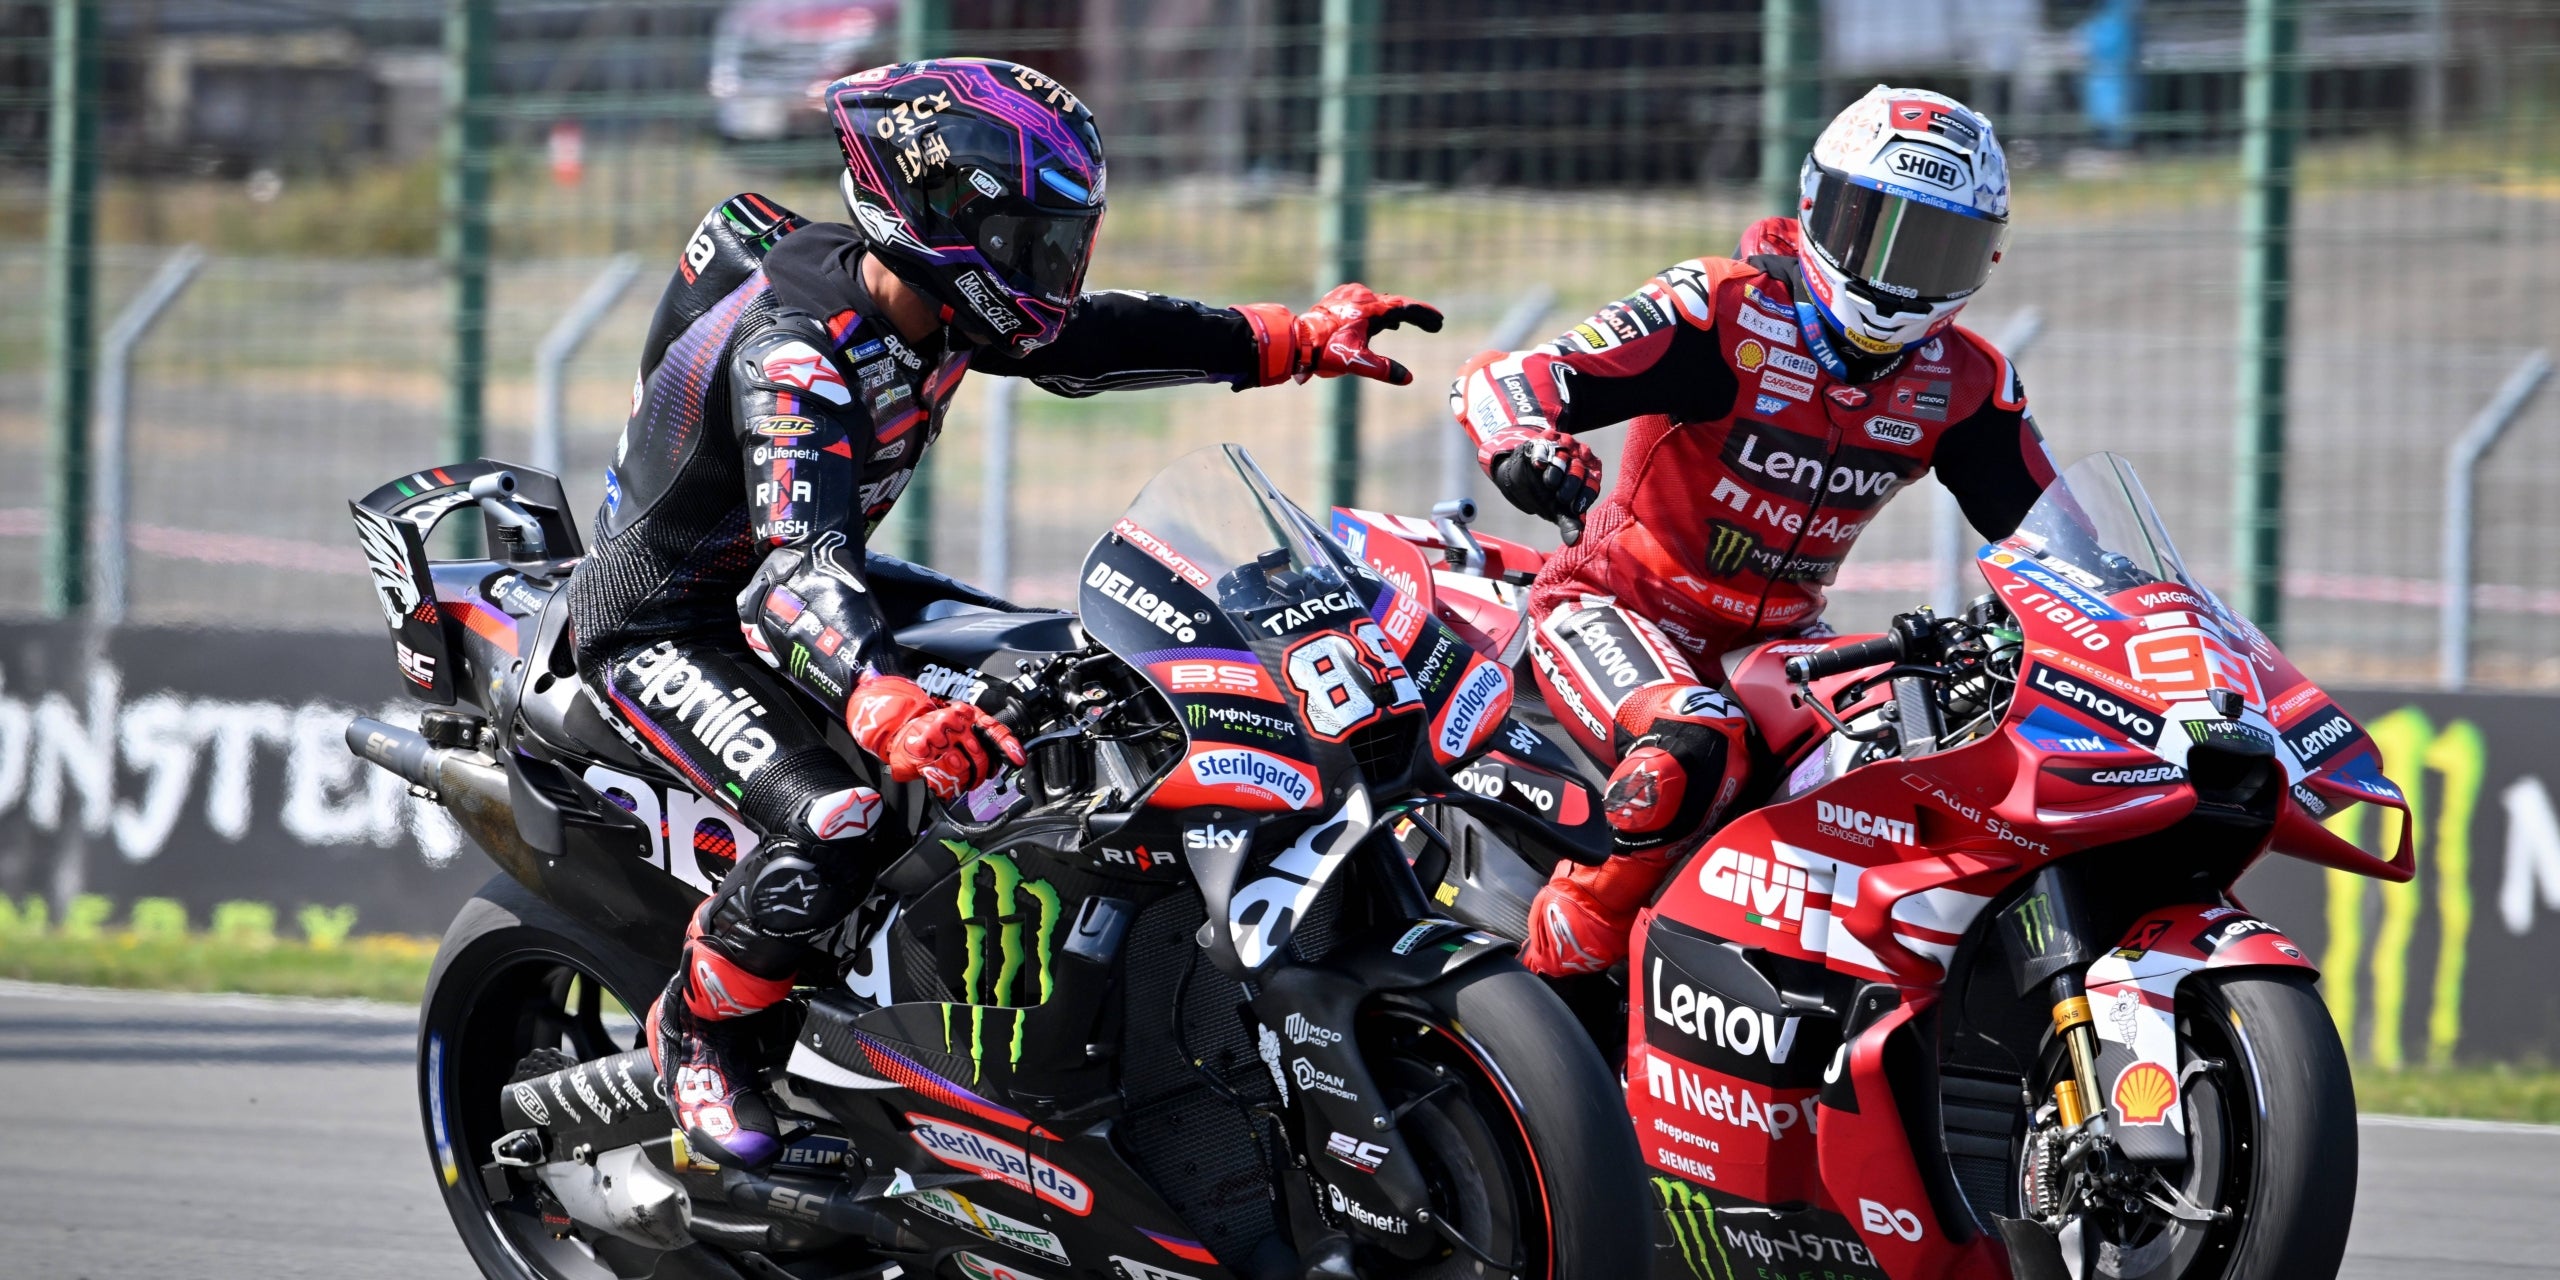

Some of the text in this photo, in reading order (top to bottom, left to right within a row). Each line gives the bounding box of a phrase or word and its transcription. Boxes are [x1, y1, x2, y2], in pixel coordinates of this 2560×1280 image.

[1934, 113, 1976, 137] Lenovo
[974, 174, 998, 195] 100%
[1896, 153, 1957, 186] SHOEI
[1885, 184, 1918, 201] Estrella
[1814, 240, 1841, 269] VERTICAL
[1868, 276, 1919, 299] Insta360
[1743, 312, 1793, 338] EATALY
[884, 334, 923, 370] aprilia
[1782, 355, 1817, 374] riello
[1813, 339, 1839, 370] TIM
[1763, 375, 1811, 394] CARRERA
[1914, 364, 1951, 374] motorola
[1504, 375, 1534, 414] Lenovo
[1755, 396, 1782, 413] SAP
[1917, 393, 1946, 404] Lenovo
[1873, 420, 1915, 440] SHOEI
[767, 448, 820, 462] Lifenet.it
[1737, 434, 1898, 497] Lenovo
[756, 520, 809, 540] MARSH
[1753, 500, 1869, 543] NetApp
[1347, 526, 1367, 559] TIM
[1383, 595, 1418, 642] BS
[2022, 593, 2110, 651] riello
[396, 641, 436, 678] SC
[1570, 611, 1640, 687] Lenovo
[1171, 664, 1259, 687] BS
[1429, 651, 1457, 694] ENERGY
[2061, 656, 2158, 702] FRECCIAROSSA
[625, 640, 777, 782] aprilia
[1446, 665, 1503, 751] sterilgarda
[2035, 669, 2155, 736] Lenovo
[1223, 723, 1285, 741] ENERGY
[1506, 721, 1543, 755] sky
[2059, 736, 2106, 751] TIM
[2289, 716, 2353, 762] Lenovo
[365, 732, 401, 764] SC
[1197, 753, 1308, 803] sterilgarda
[2091, 765, 2184, 784] CARRERA
[2358, 779, 2400, 800] TIM
[1234, 784, 1274, 802] alimenti
[1816, 800, 1916, 847] DUCATI
[1817, 822, 1875, 848] DESMOSEDICI
[1931, 788, 2050, 856] Audi Sport
[1187, 824, 1248, 854] sky
[1699, 846, 1808, 921] GIVI
[1396, 926, 1424, 951] Green
[1308, 1024, 1343, 1043] MOD
[1315, 1082, 1358, 1102] COMPOSITI
[1316, 1071, 1345, 1088] PAN
[1327, 1131, 1390, 1165] SC
[1654, 1117, 1720, 1154] streparava
[917, 1125, 1077, 1201] sterilgarda
[1658, 1147, 1716, 1182] SIEMENS
[770, 1186, 828, 1216] SC
[1344, 1197, 1409, 1235] Lifenet.it
[986, 1212, 1052, 1249] Power
